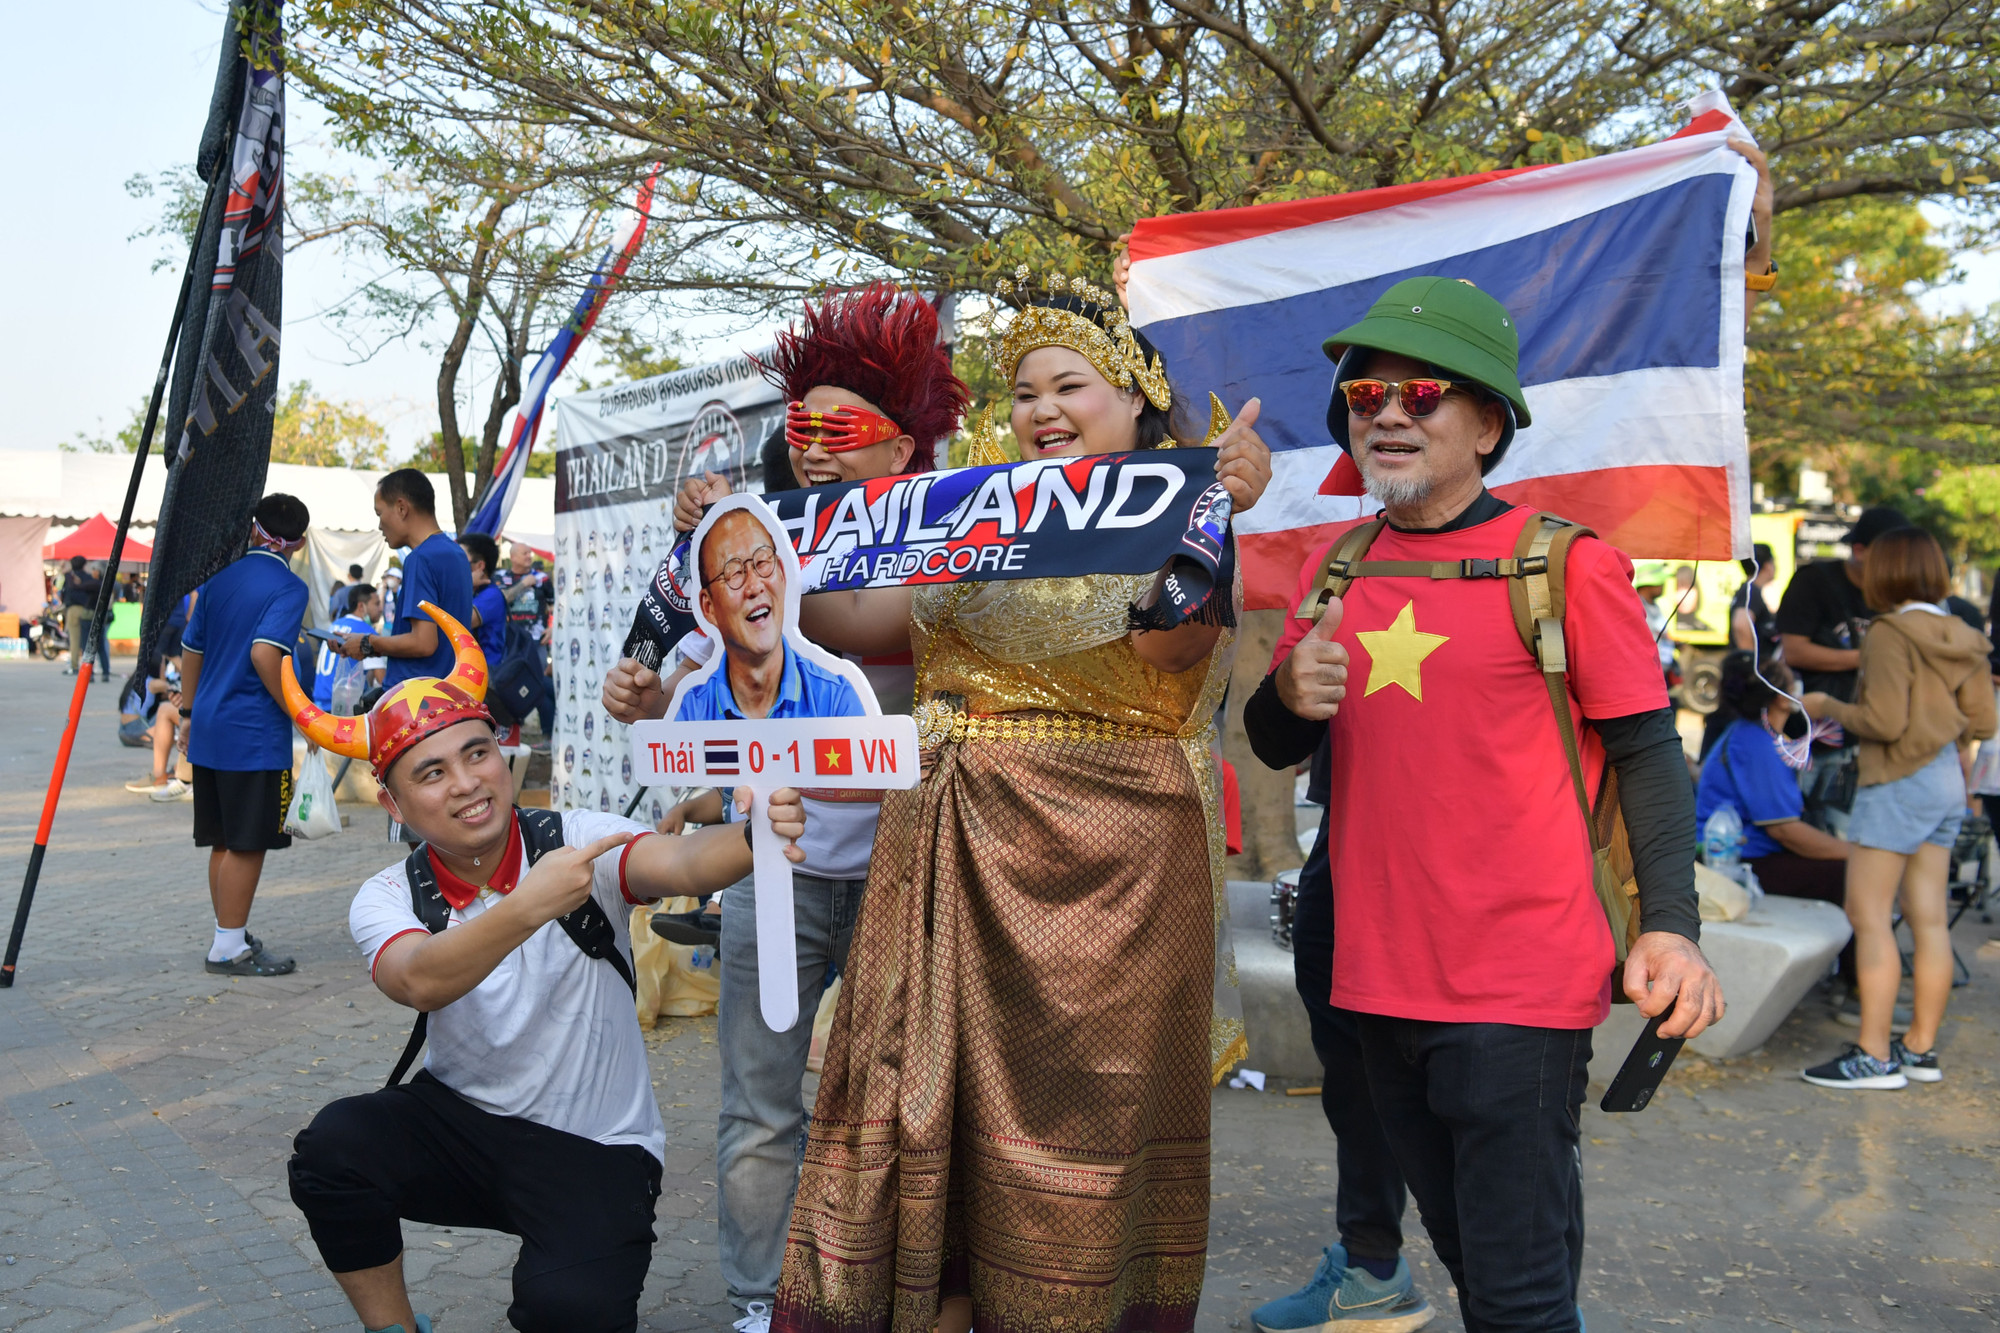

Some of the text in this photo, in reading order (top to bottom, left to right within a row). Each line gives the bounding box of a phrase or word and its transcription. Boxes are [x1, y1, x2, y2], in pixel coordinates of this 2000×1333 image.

[566, 438, 669, 500] THAILAND
[768, 463, 1186, 554] HAILAND
[821, 544, 1030, 583] HARDCORE
[1165, 573, 1186, 605] 2015
[649, 605, 671, 634] 2015
[647, 741, 695, 774] Thái
[859, 739, 897, 774] VN
[839, 789, 877, 799] QUARTER
